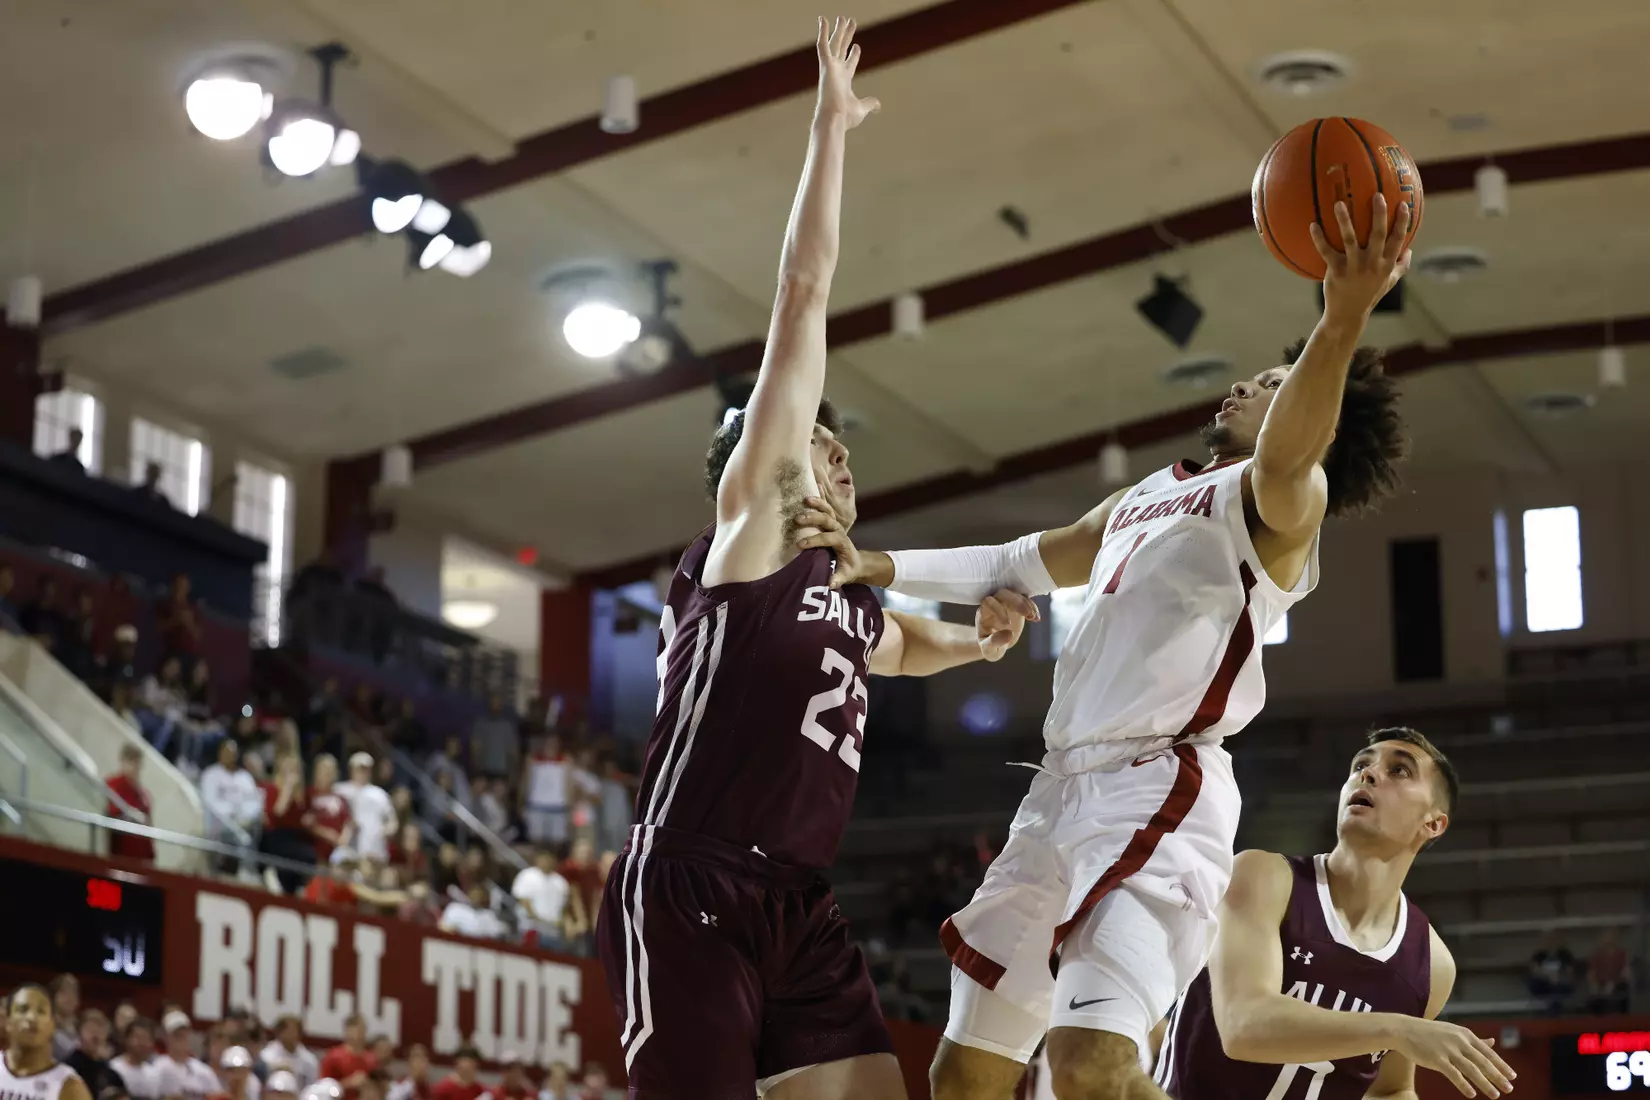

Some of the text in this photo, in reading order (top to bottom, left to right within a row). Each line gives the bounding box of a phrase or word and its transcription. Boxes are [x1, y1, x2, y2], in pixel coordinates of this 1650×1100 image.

[1105, 484, 1218, 538] ALABAMA
[1102, 532, 1148, 595] 1
[800, 647, 868, 774] 23
[193, 890, 582, 1072] ROLL TIDE
[1606, 1050, 1650, 1091] 69
